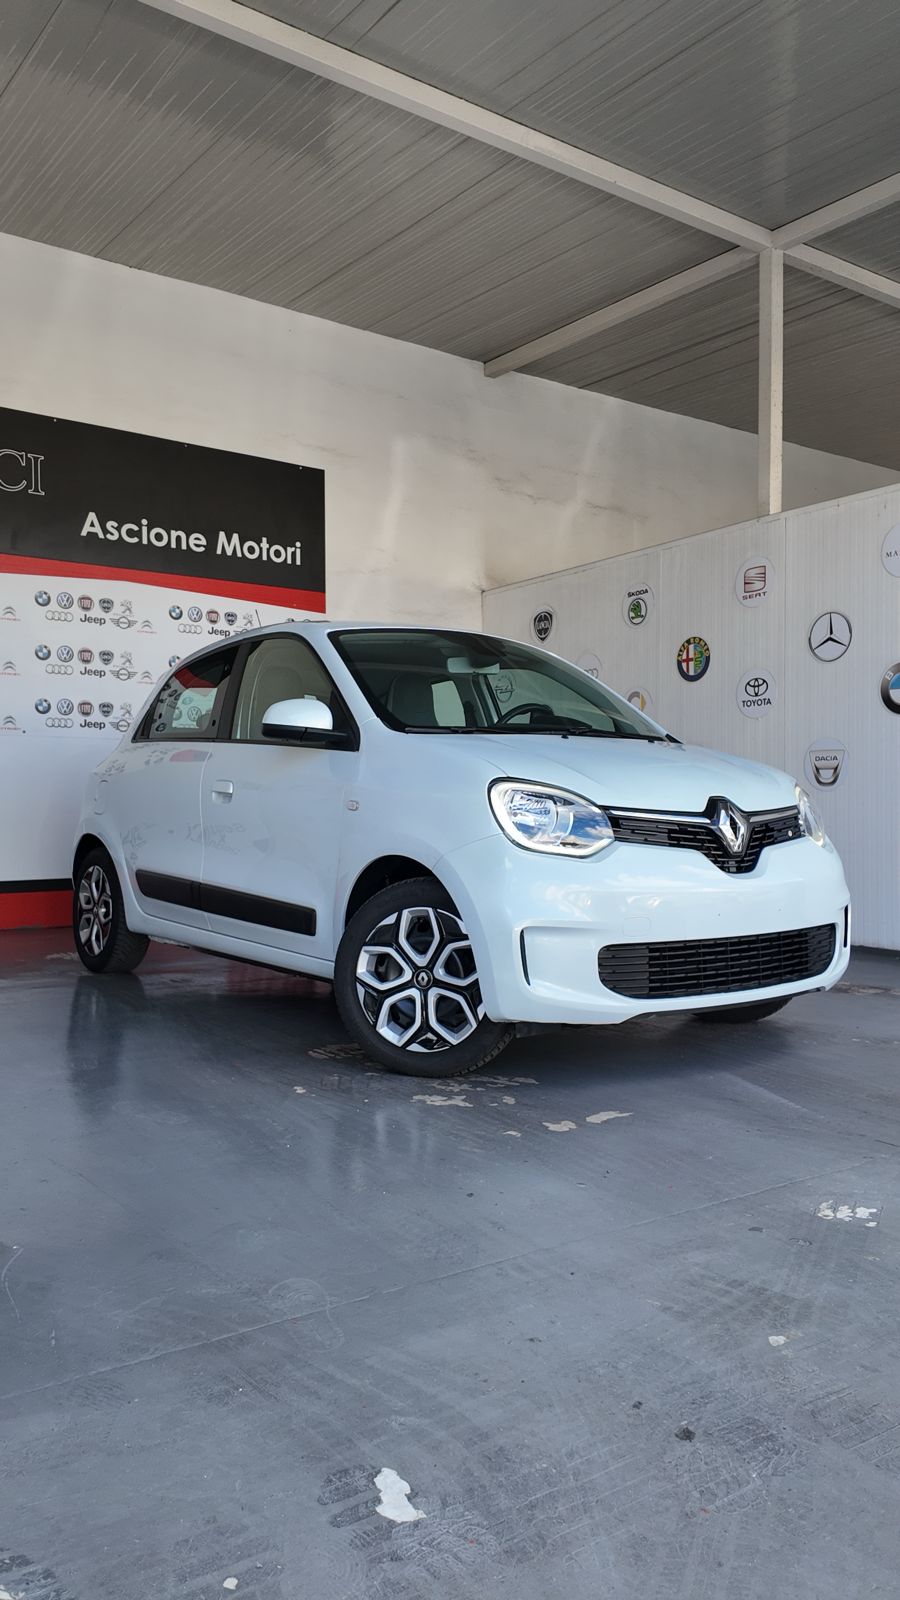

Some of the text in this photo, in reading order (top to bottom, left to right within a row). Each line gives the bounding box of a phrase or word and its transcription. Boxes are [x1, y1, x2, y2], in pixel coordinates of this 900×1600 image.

[80, 511, 302, 566] Ascione Motori
[742, 591, 768, 600] SEAT
[80, 614, 106, 626] Jeep
[207, 626, 231, 638] Jeep
[80, 666, 106, 678] Jeep
[742, 698, 772, 708] TOYOTA
[80, 719, 106, 730] Jeep
